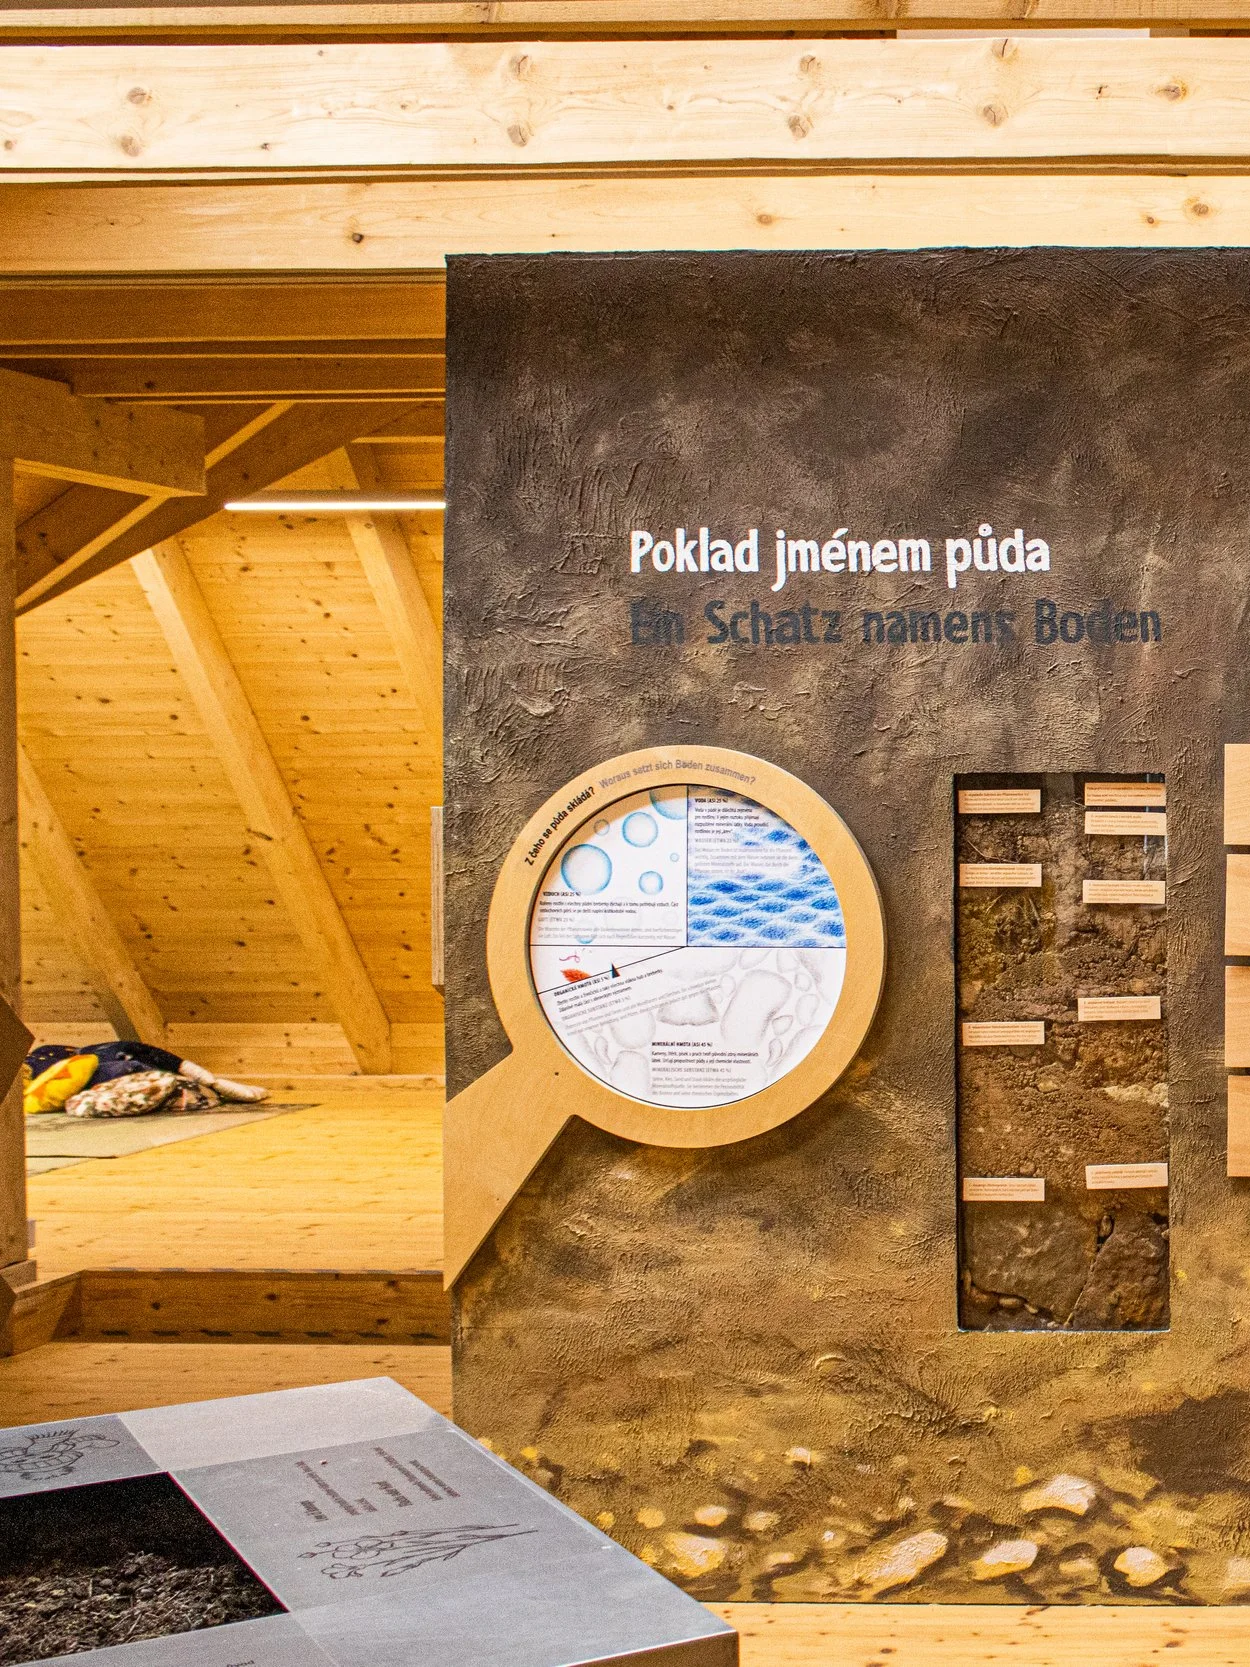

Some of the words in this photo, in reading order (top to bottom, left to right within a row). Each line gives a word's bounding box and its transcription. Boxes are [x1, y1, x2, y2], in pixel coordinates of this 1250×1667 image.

[630, 528, 760, 573] Poklad
[772, 528, 932, 592] jménem
[946, 522, 1051, 589] půda
[704, 599, 842, 645] Schatz
[863, 610, 1015, 645] namens
[1034, 598, 1162, 645] Boden
[599, 771, 632, 789] Woraus
[632, 764, 653, 777] setzt
[655, 760, 674, 771] sich
[675, 759, 703, 771] Boden
[705, 763, 757, 786] zusammen?
[525, 857, 535, 866] Z
[542, 828, 553, 839] se
[550, 811, 569, 831] půda
[567, 786, 596, 813] skládá?
